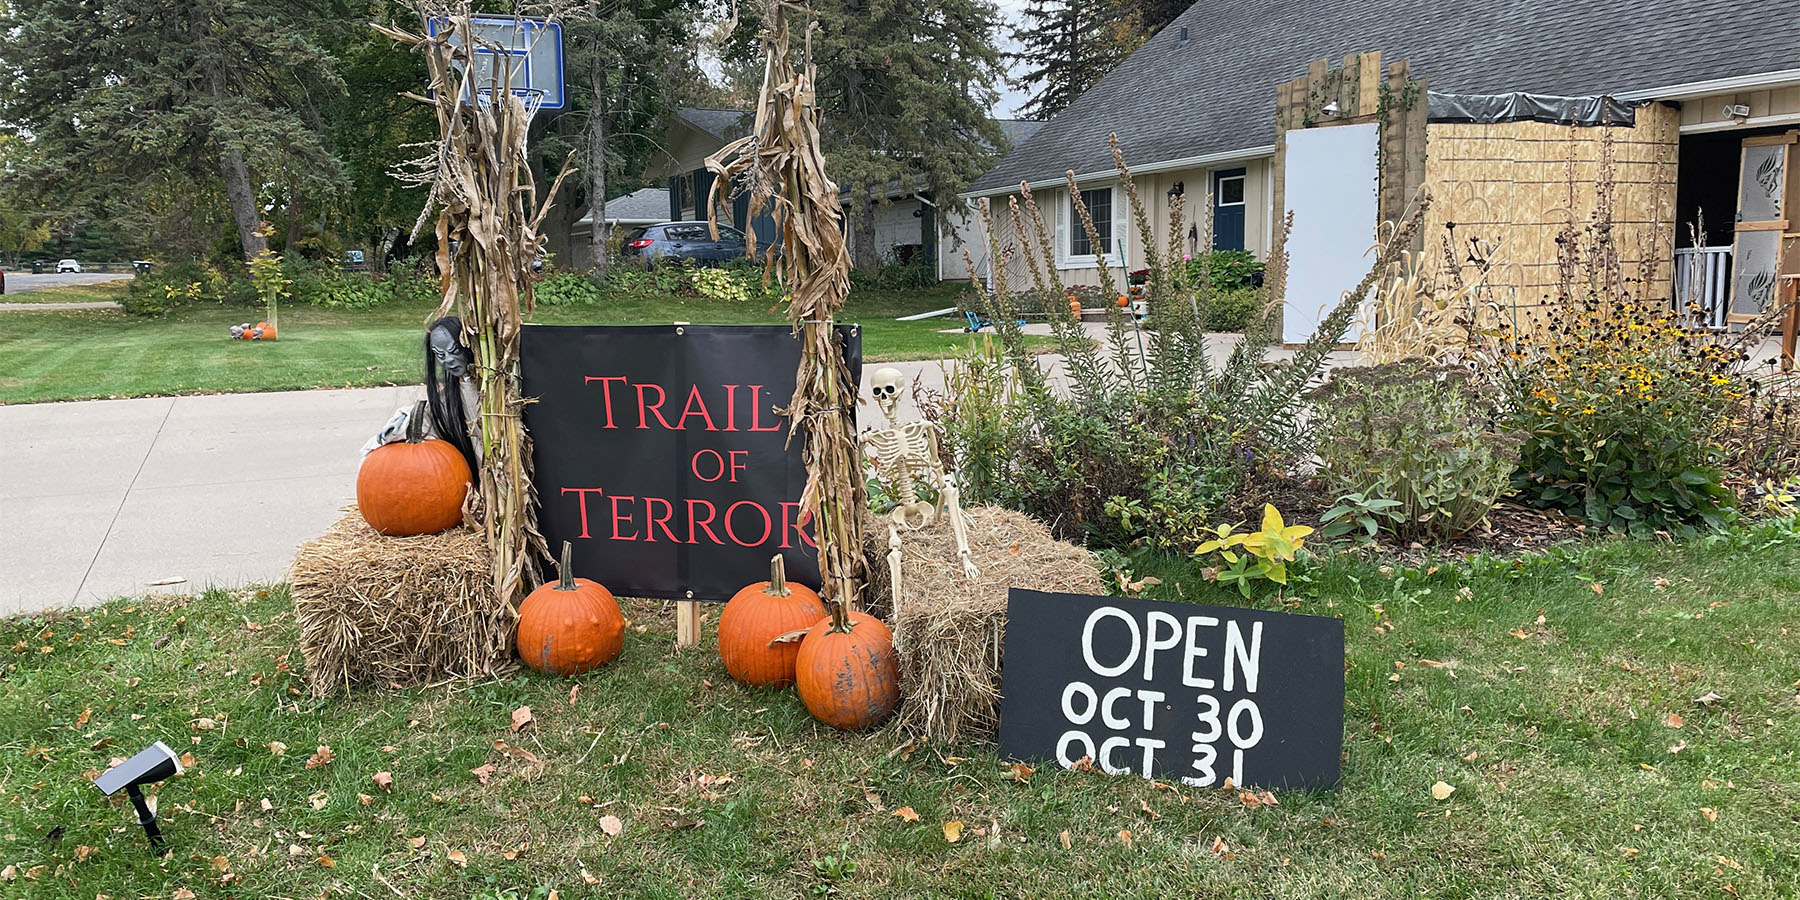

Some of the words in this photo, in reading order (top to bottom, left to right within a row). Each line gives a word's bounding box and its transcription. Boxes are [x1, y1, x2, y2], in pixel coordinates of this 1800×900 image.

[584, 375, 783, 431] TRAIL
[691, 449, 749, 483] OF
[561, 487, 817, 549] TERROR
[1081, 606, 1263, 693] OPEN
[1061, 681, 1166, 731] OCT
[1191, 694, 1264, 750] 30
[1055, 730, 1166, 780] OCT
[1181, 743, 1244, 789] 31
